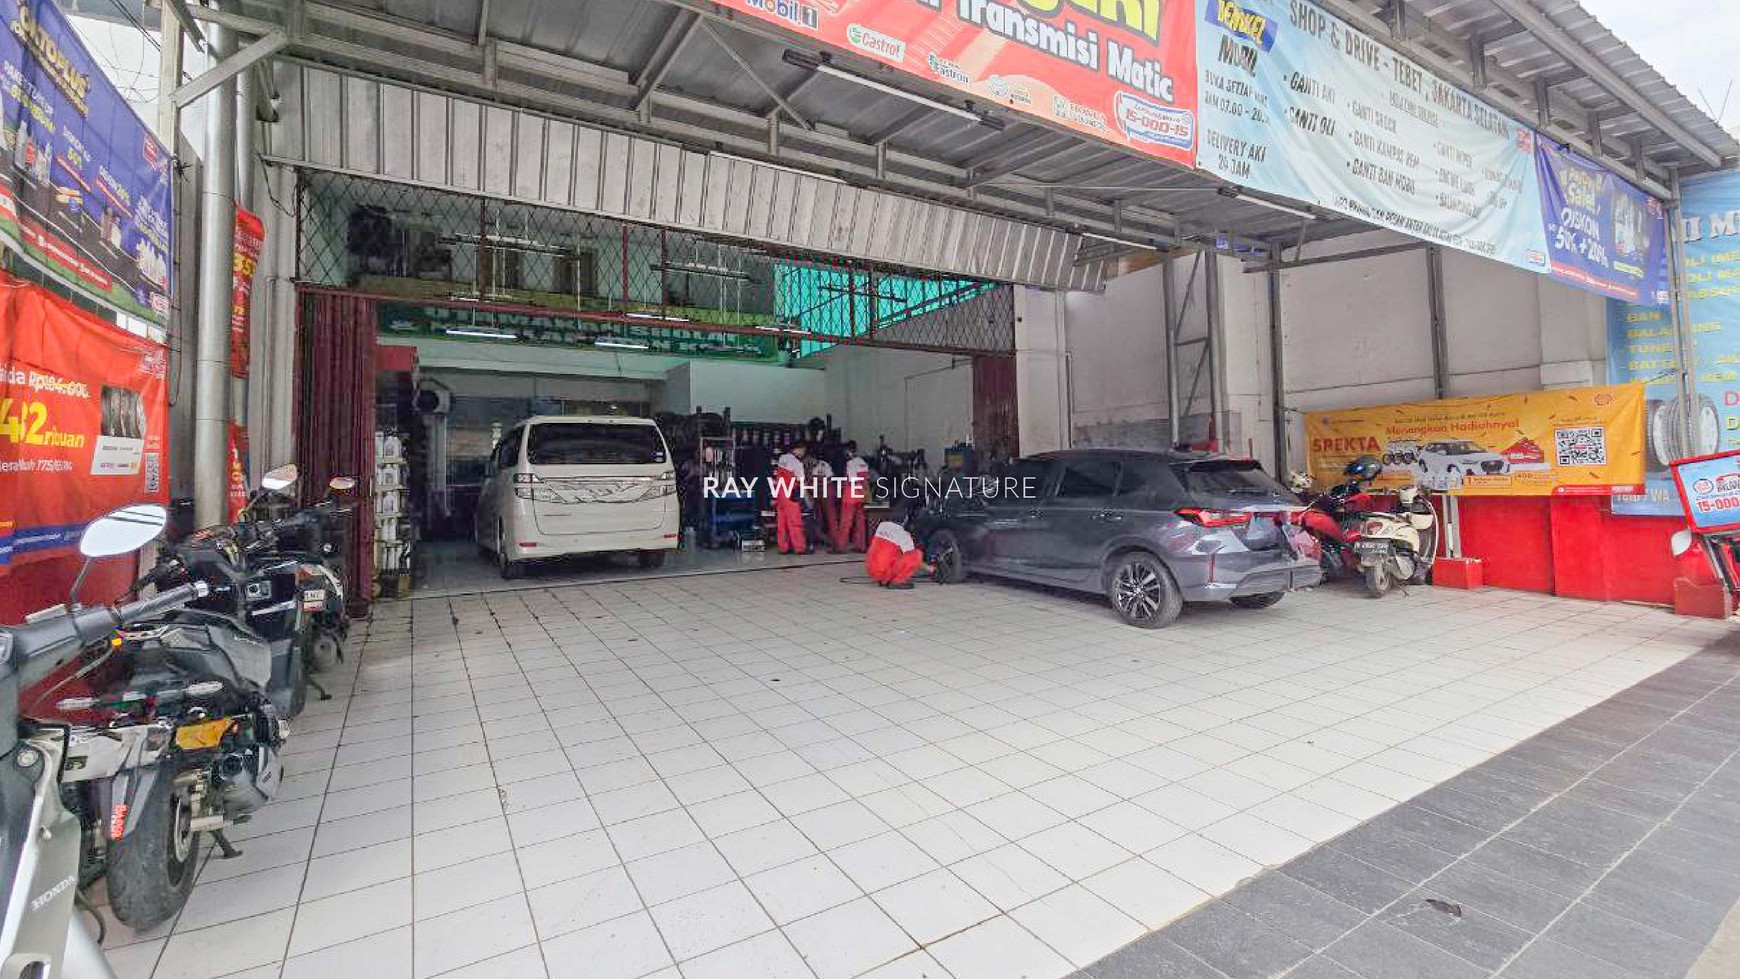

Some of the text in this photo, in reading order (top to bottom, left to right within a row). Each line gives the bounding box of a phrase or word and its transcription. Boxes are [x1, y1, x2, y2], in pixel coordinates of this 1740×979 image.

[1290, 0, 1326, 39] SHOP
[1331, 22, 1339, 49] &
[1346, 28, 1380, 71] DRIVE
[1107, 40, 1174, 101] Matic
[1290, 71, 1319, 98] GANTI
[31, 875, 77, 912] HONDA
